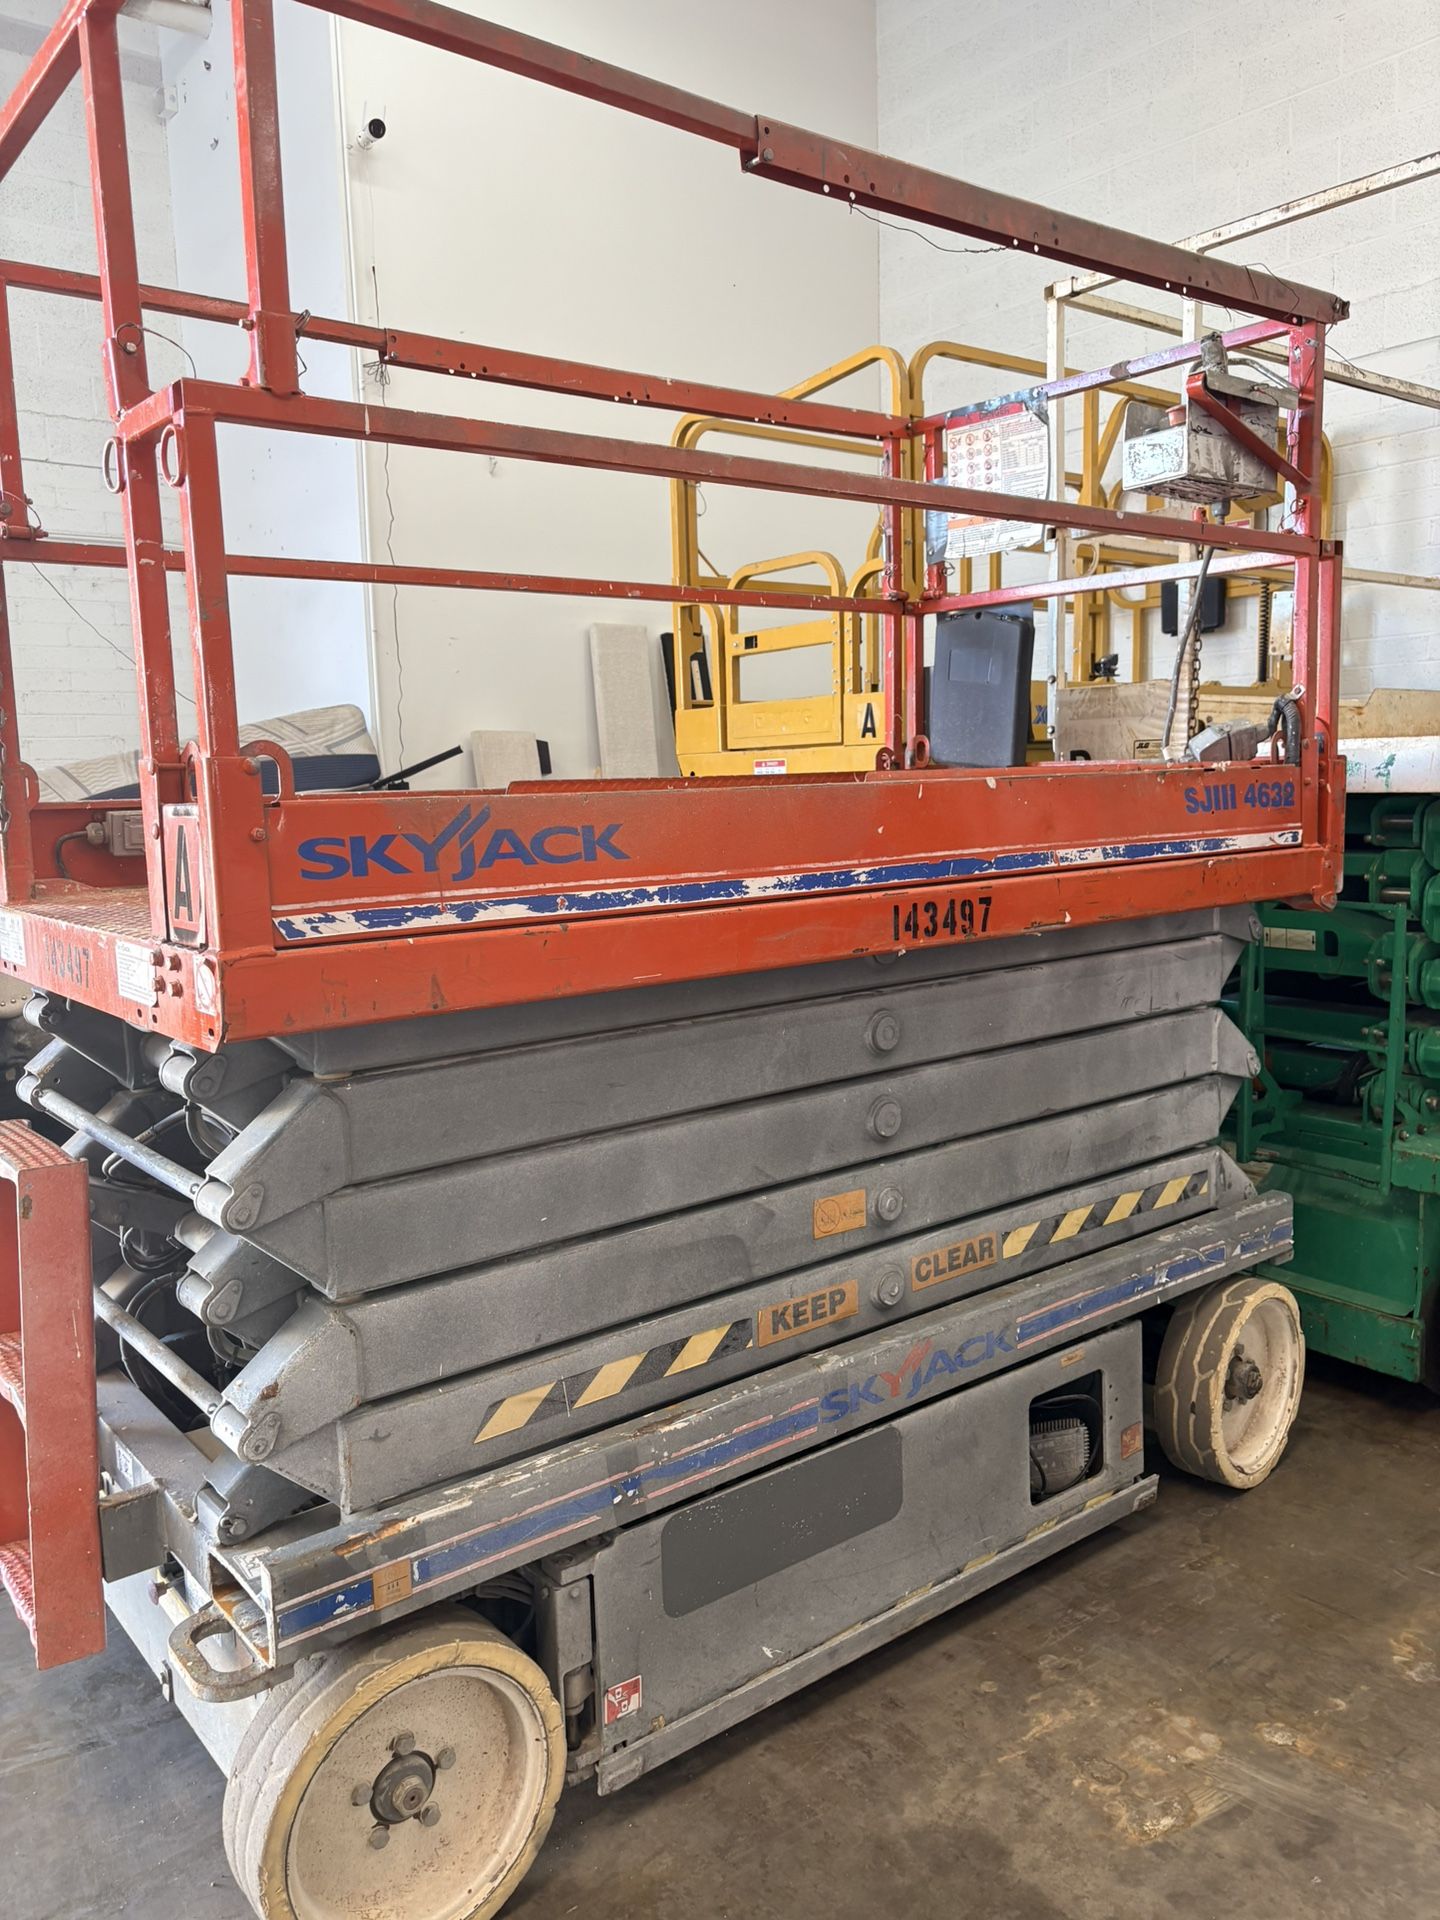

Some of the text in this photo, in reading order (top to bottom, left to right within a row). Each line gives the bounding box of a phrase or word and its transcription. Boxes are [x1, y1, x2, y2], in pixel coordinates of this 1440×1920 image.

[861, 702, 877, 738] A
[1244, 782, 1296, 808] 4632
[298, 804, 631, 881] SKYJACK
[174, 825, 193, 921] A
[893, 896, 993, 943] 143497
[915, 1237, 995, 1284] CLEAR
[770, 1288, 847, 1335] KEEP
[819, 1326, 1015, 1424] SKYJACK
